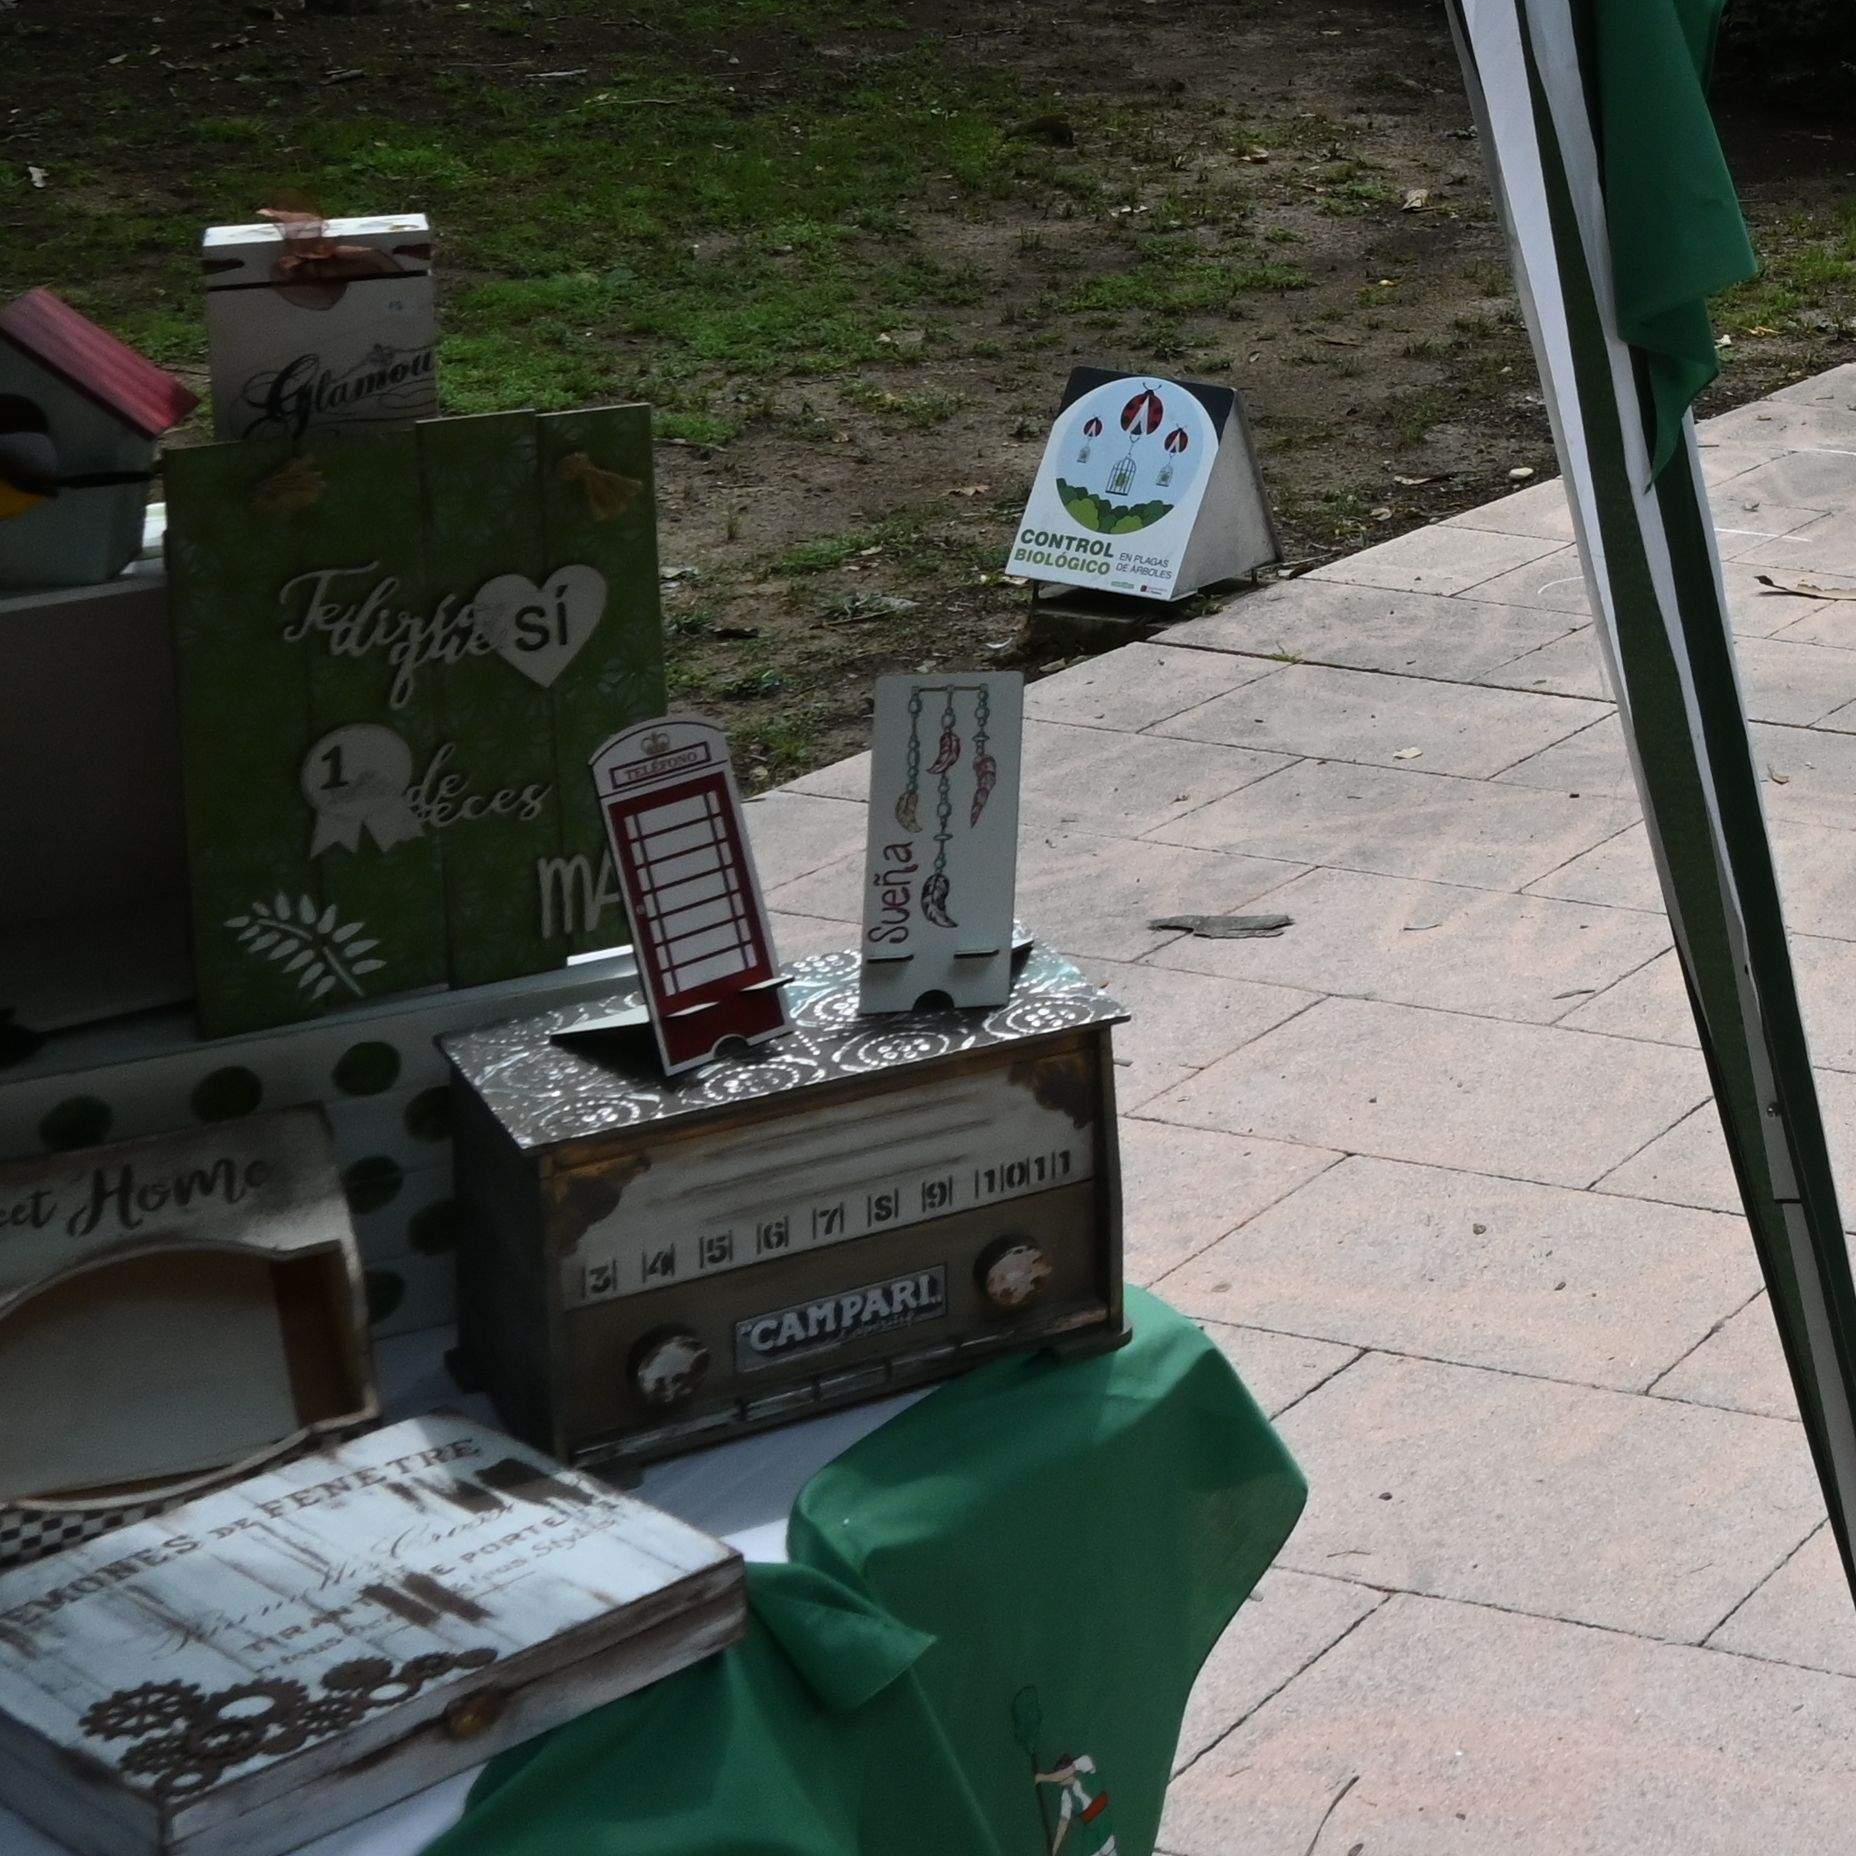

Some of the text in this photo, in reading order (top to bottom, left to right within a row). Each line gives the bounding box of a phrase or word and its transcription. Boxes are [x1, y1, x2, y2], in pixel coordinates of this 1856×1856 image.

[1021, 529, 1114, 558] CONTROL
[1014, 548, 1111, 575] BIOLÓGICO
[1116, 563, 1129, 572] DE
[1119, 553, 1170, 568] EN PLAGAS
[868, 841, 920, 944] Sueña
[66, 1158, 275, 1237] Home
[750, 1274, 936, 1352] CAMPARI
